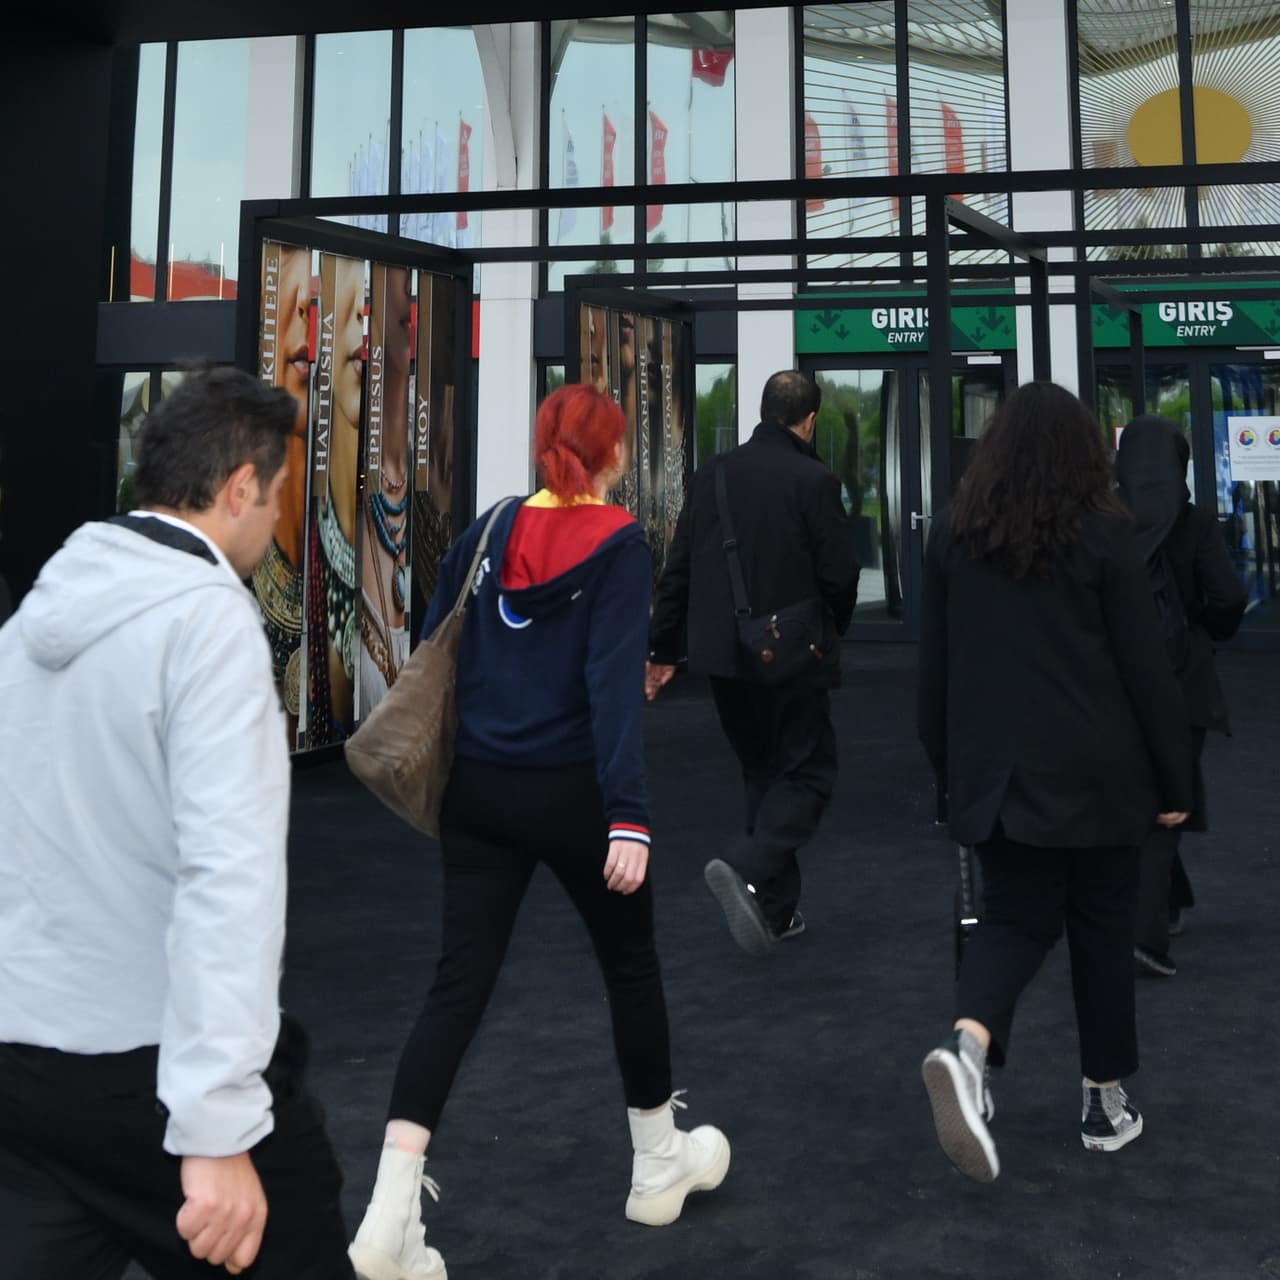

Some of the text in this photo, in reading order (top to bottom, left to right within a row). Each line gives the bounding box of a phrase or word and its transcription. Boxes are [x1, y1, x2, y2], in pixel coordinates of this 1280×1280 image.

[262, 257, 279, 381] KLITEPE
[887, 331, 925, 344] ENTRY
[1176, 325, 1217, 337] ENTRY
[316, 312, 334, 471] HATTUSHA
[369, 345, 383, 470] EPHESUS
[417, 396, 429, 471] TROY
